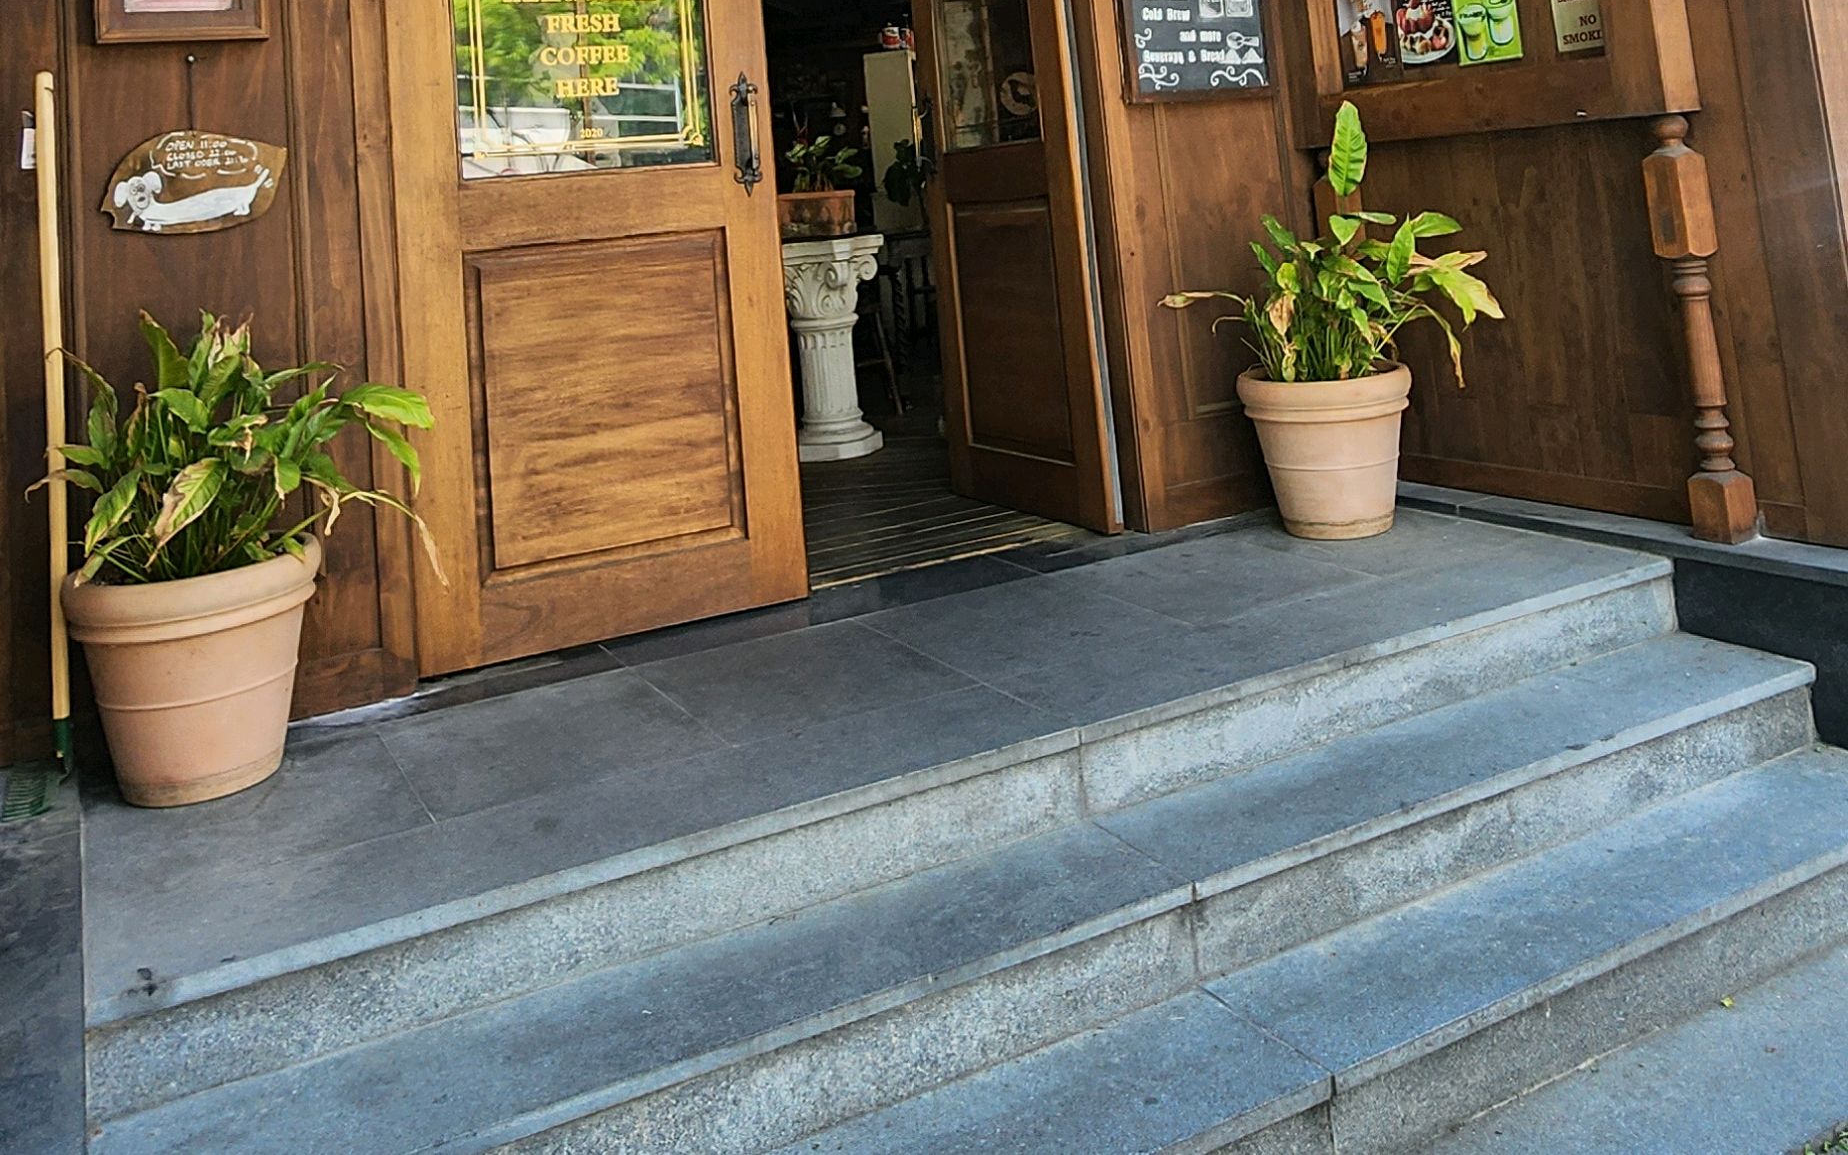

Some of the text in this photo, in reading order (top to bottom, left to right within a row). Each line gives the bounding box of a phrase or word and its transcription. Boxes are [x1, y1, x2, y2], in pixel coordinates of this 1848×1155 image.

[1142, 7, 1190, 21] Cold Brew
[1579, 14, 1597, 26] NO
[546, 13, 620, 34] FRESH
[540, 45, 630, 66] COFFEE
[556, 77, 620, 98] HERE
[580, 127, 603, 138] 2020
[165, 140, 194, 152] OPEN
[167, 160, 191, 170] LAST
